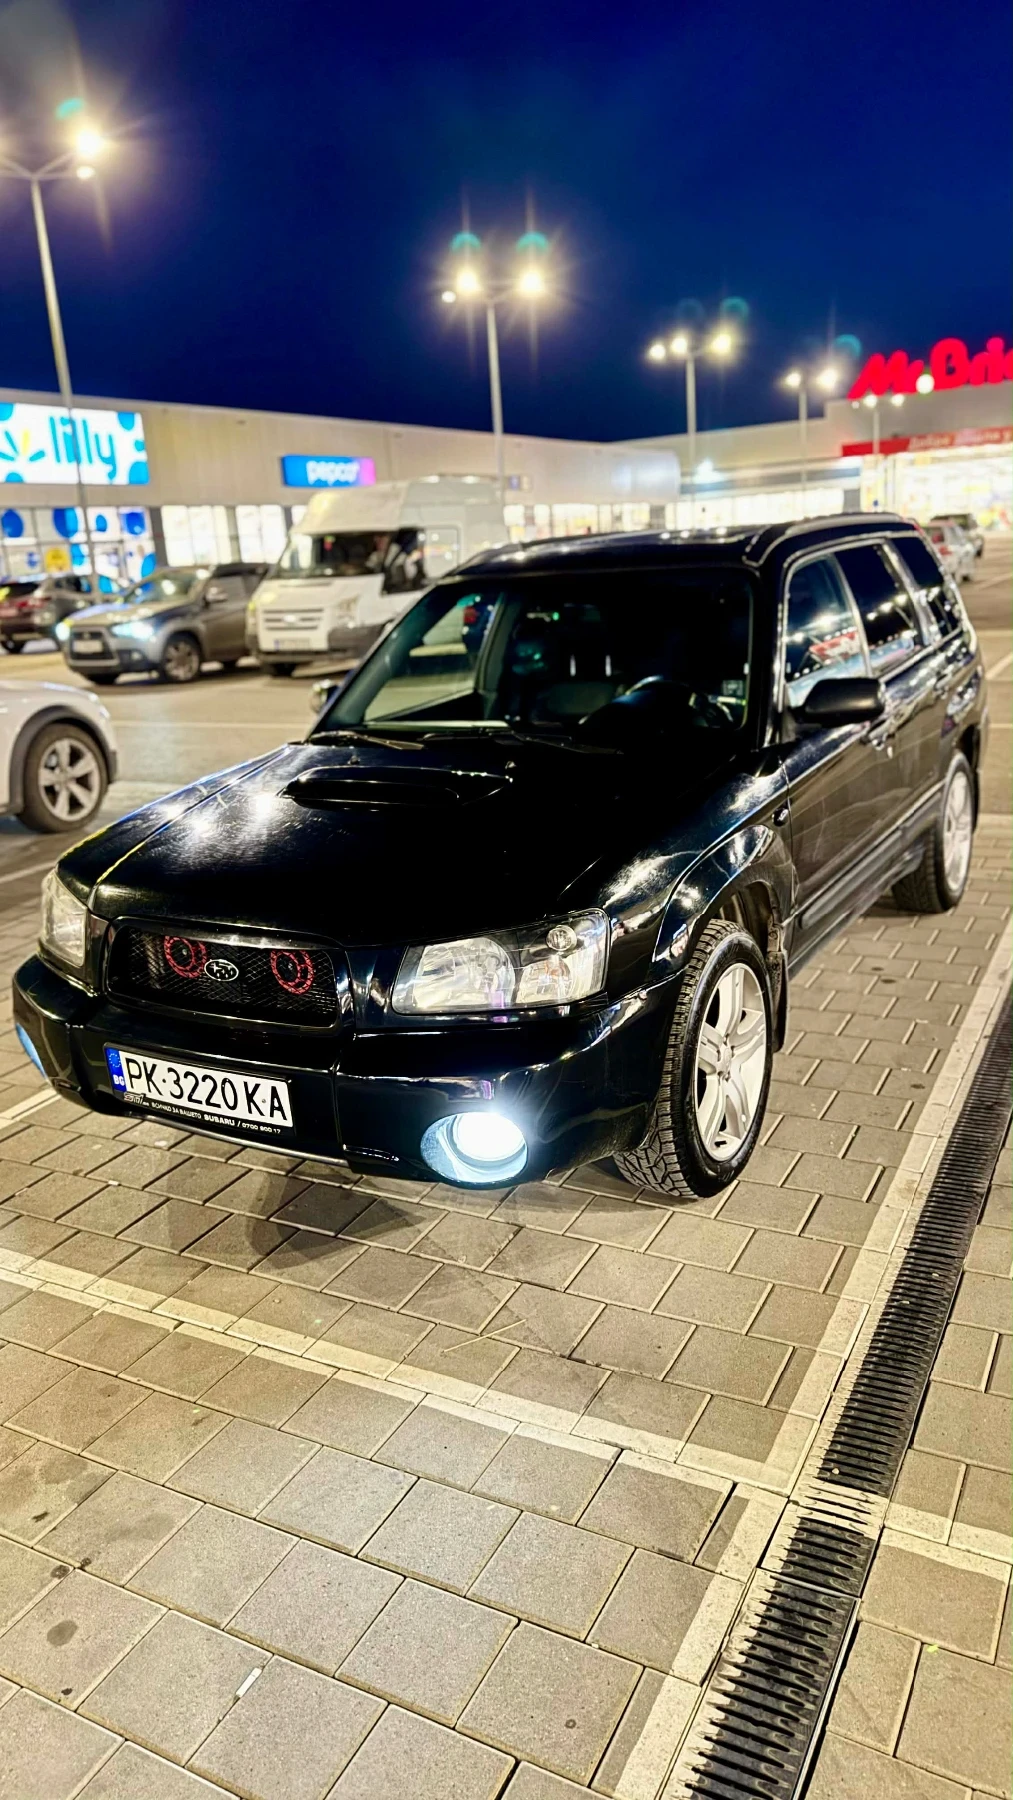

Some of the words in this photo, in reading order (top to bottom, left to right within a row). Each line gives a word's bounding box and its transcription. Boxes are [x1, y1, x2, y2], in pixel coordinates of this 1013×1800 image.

[49, 416, 117, 480] lilly
[113, 1074, 125, 1086] BG
[203, 1114, 235, 1126] SUBARU
[241, 1122, 259, 1130] 0700
